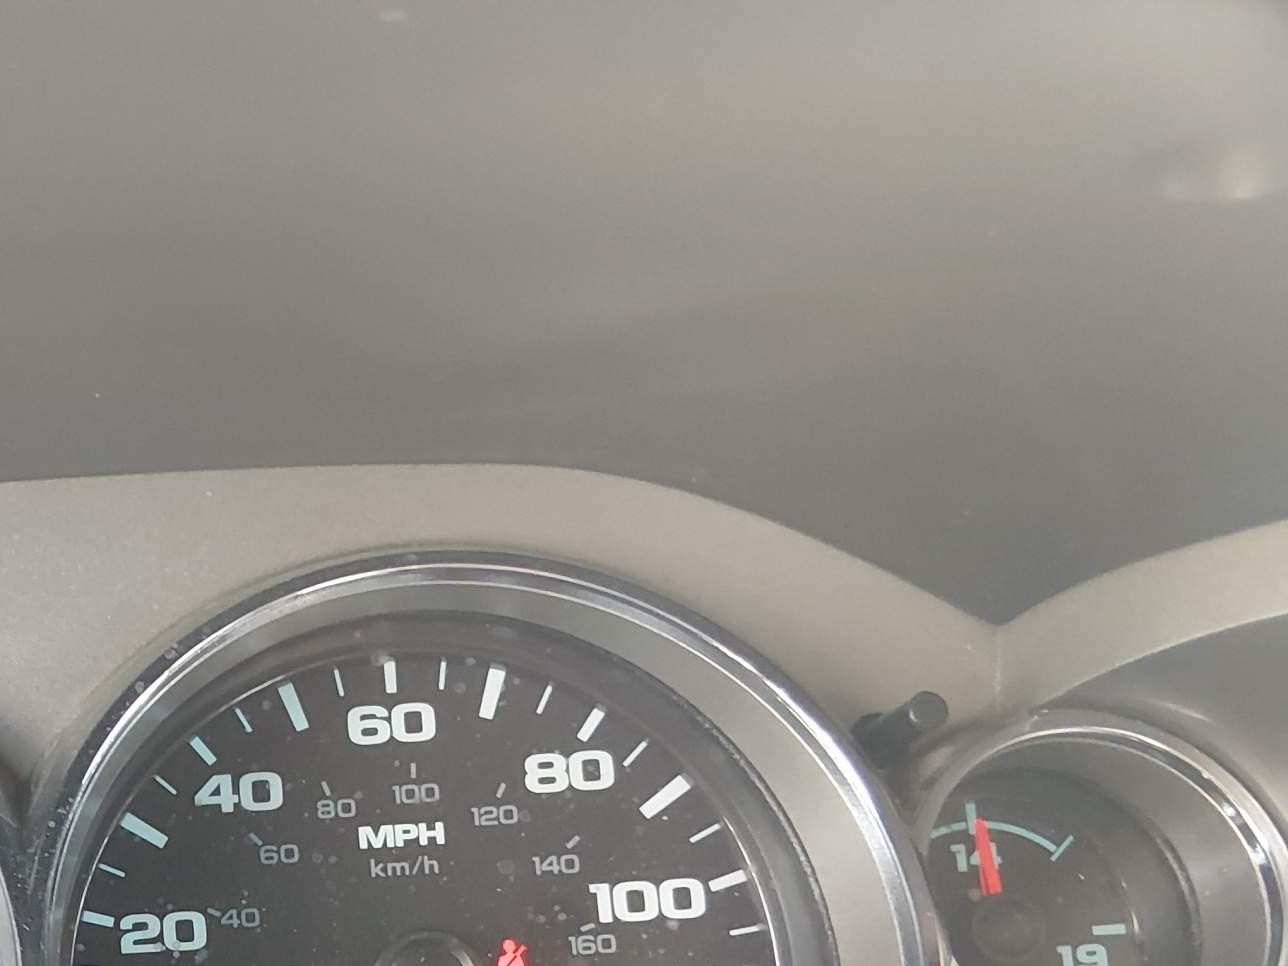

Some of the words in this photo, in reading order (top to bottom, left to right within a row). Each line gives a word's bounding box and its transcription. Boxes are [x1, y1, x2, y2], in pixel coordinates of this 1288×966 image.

[347, 702, 436, 746] 60
[524, 750, 615, 793] 80
[194, 771, 283, 813] 40
[392, 783, 440, 804] 100
[317, 798, 356, 819] 80
[471, 805, 518, 827] 120
[358, 821, 445, 850] MPH
[260, 844, 299, 864] 60
[532, 854, 580, 875] 140
[370, 855, 440, 878] km/h
[588, 878, 706, 923] 100
[220, 908, 260, 928] 40
[119, 910, 207, 954] 20
[568, 934, 616, 955] 160
